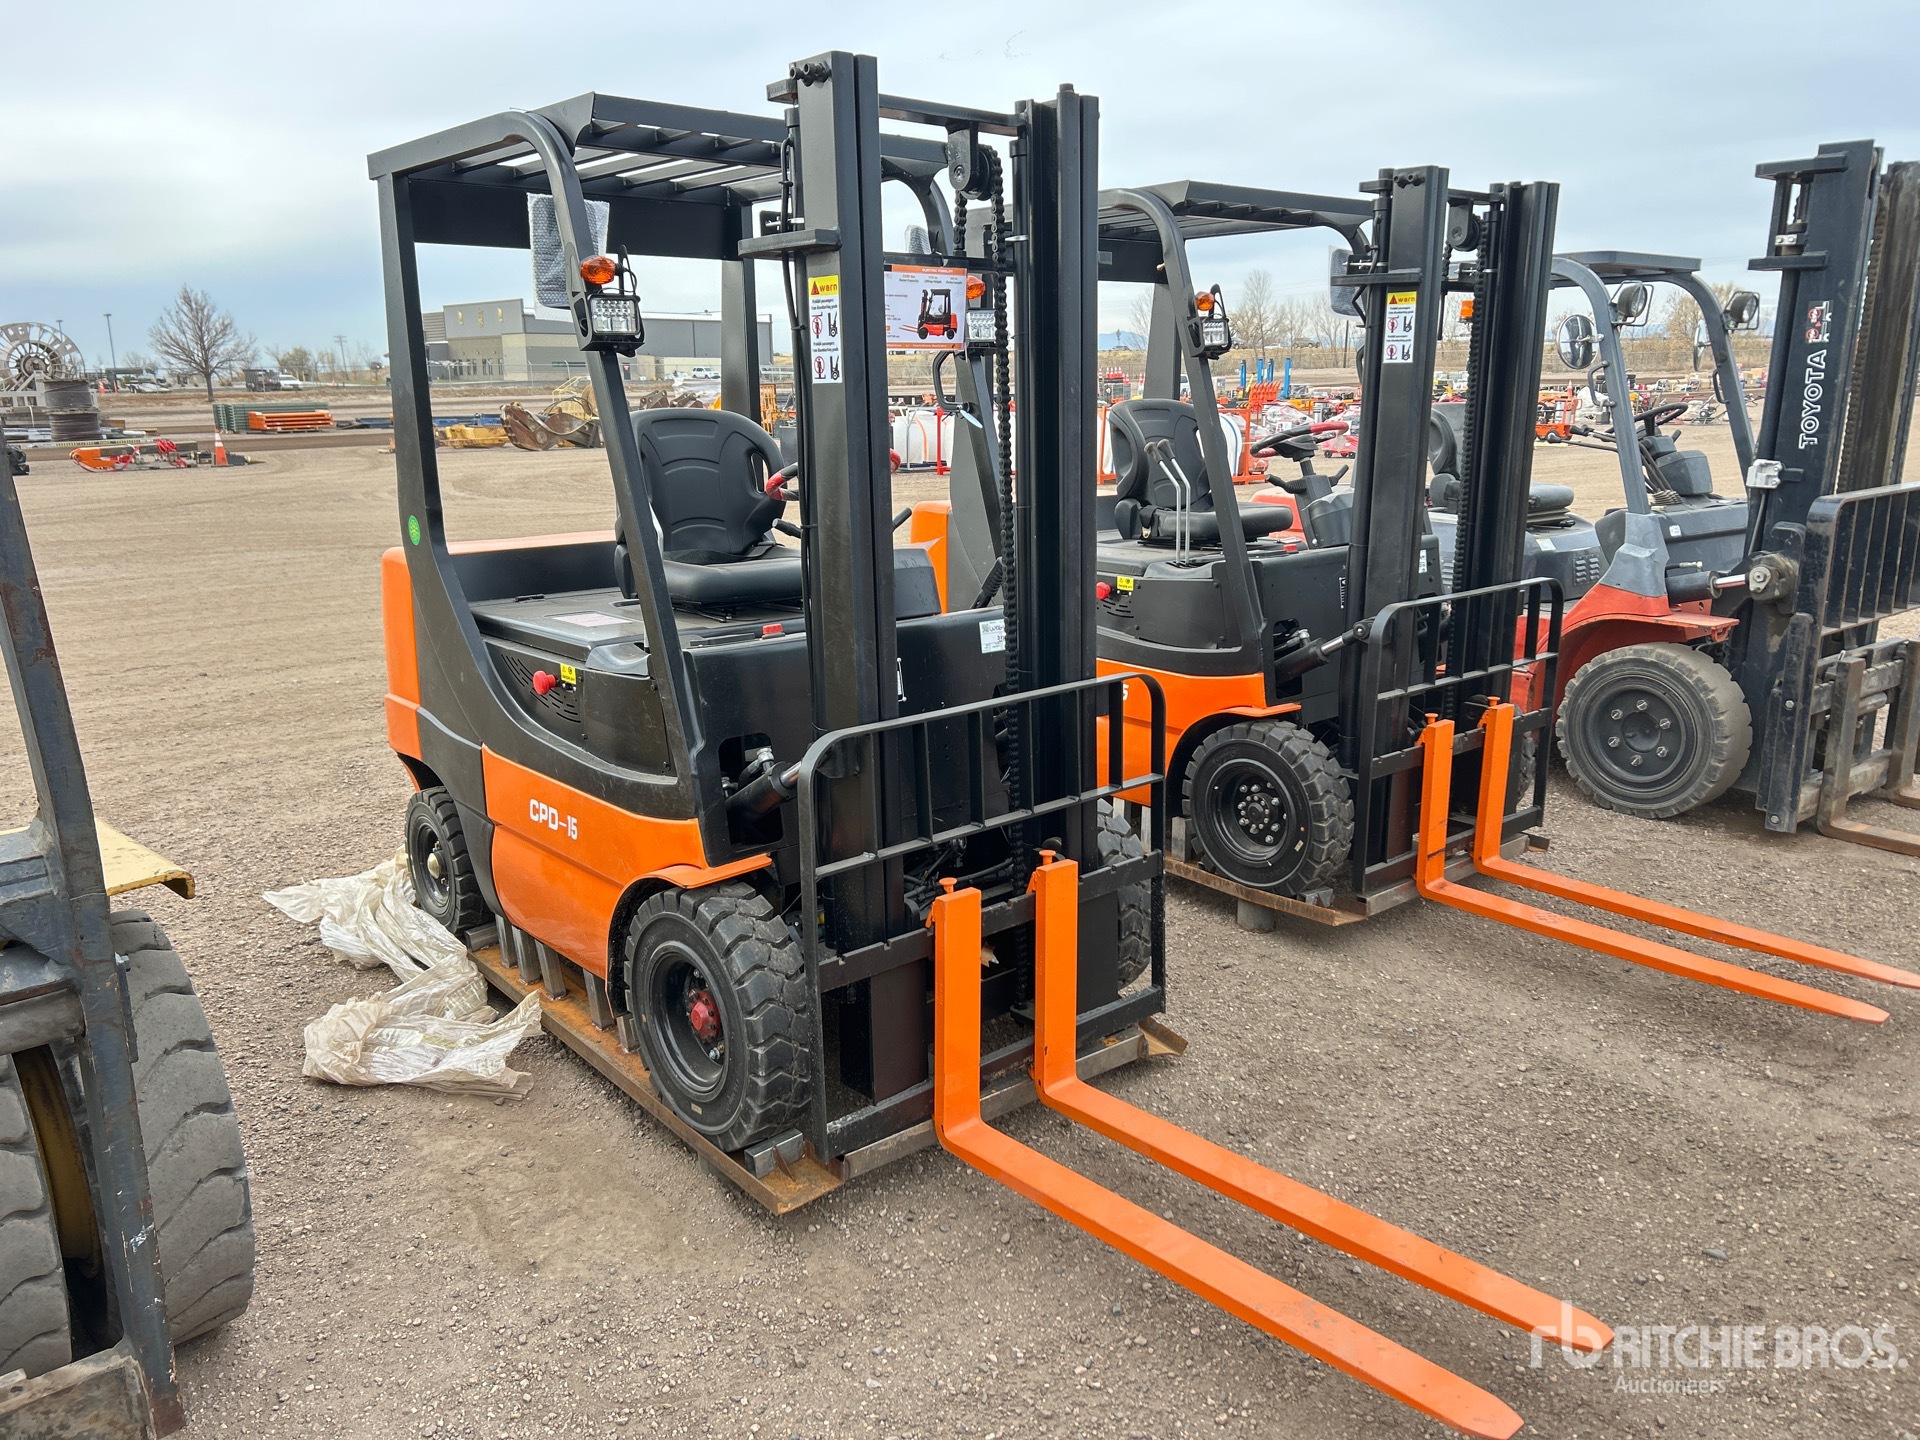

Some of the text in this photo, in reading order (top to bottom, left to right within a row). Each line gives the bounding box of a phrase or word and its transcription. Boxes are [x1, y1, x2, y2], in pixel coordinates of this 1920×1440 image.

[820, 284, 837, 292] warn
[1798, 349, 1827, 450] TOYOTA
[529, 798, 578, 840] CPD-15
